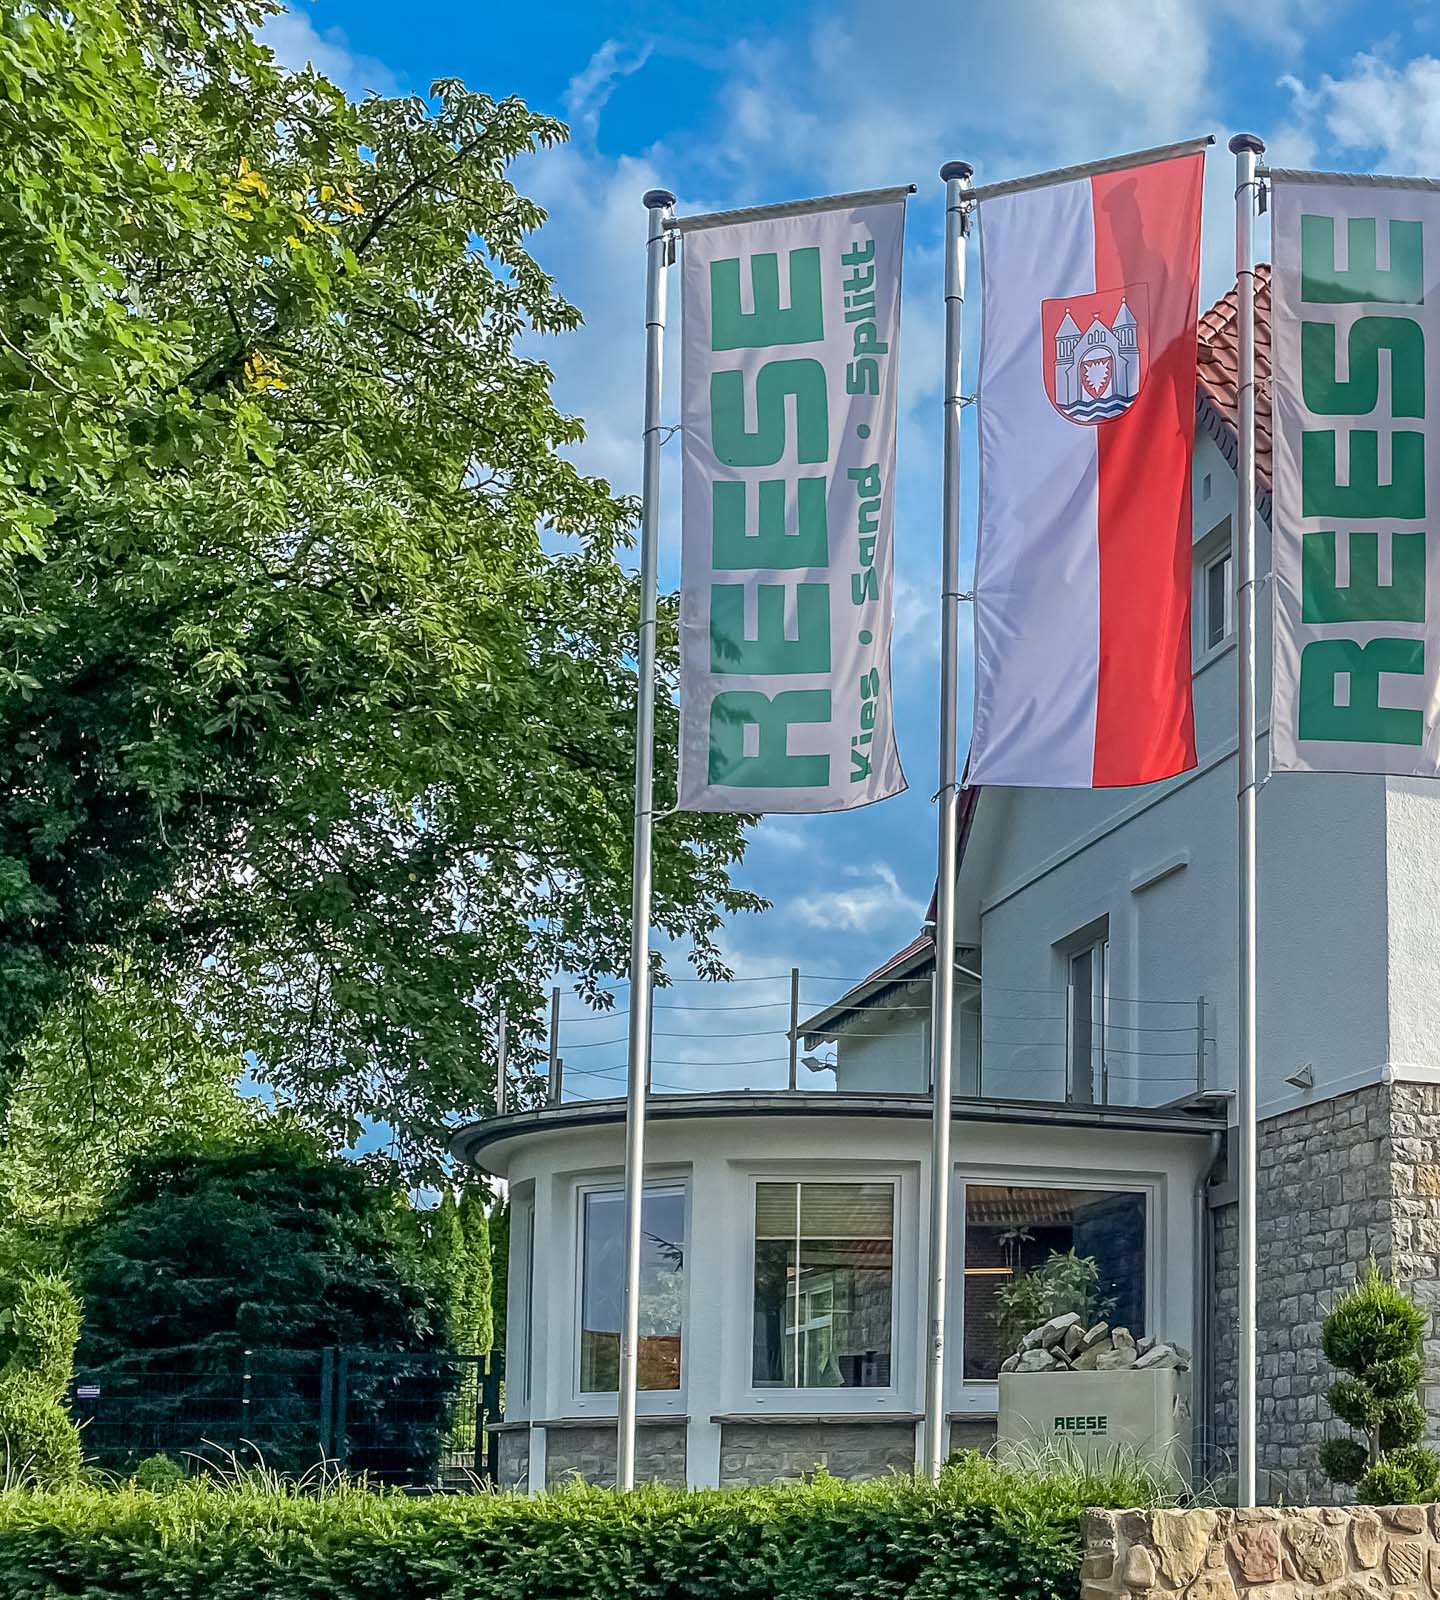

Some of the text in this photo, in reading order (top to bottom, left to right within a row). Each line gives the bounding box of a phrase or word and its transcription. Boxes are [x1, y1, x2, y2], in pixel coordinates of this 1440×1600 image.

[708, 247, 831, 787] REESE
[841, 238, 889, 783] Kies Sand Splitt
[1299, 213, 1426, 746] REESE
[1054, 1416, 1107, 1430] REESE
